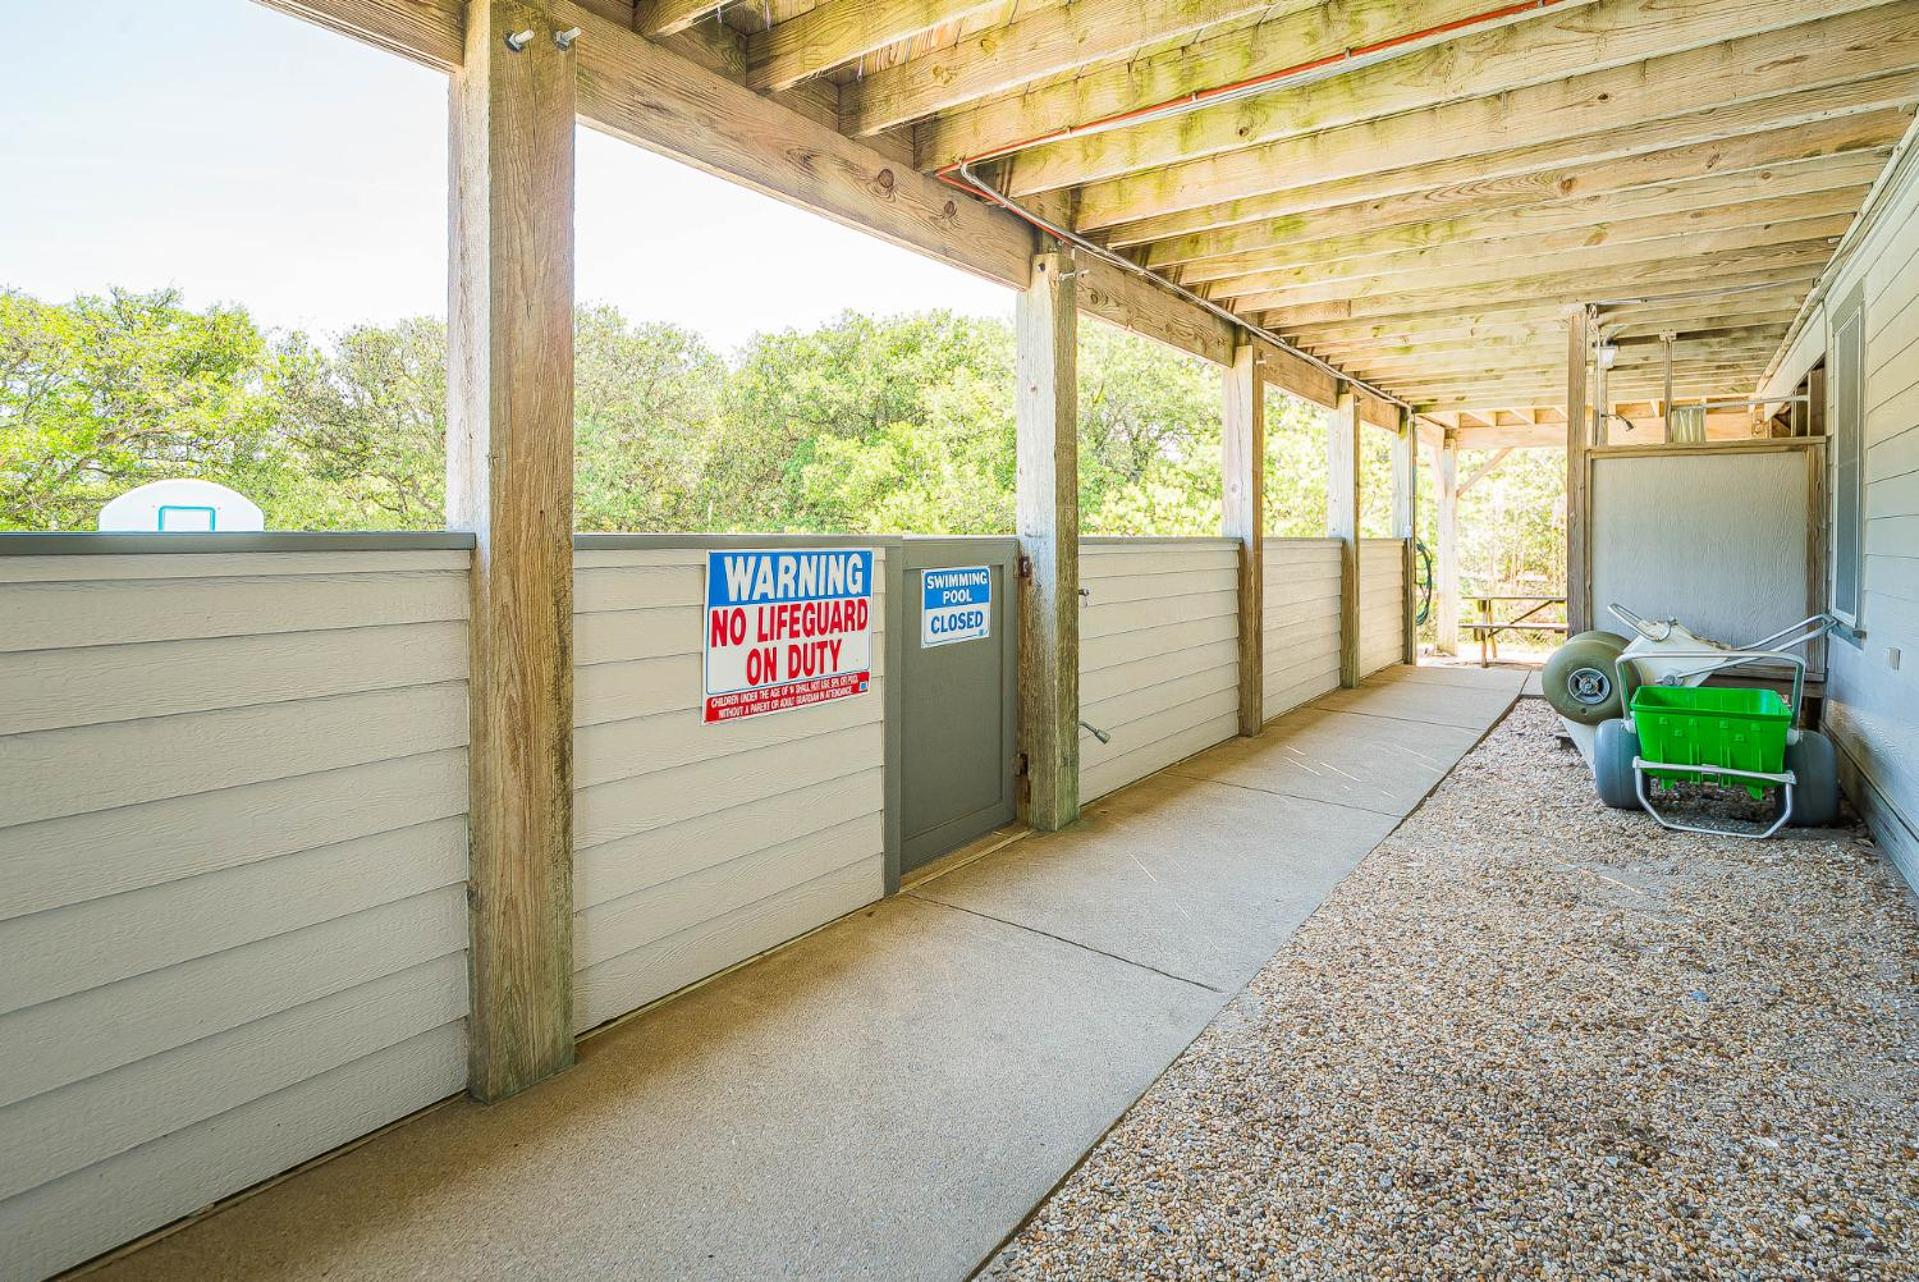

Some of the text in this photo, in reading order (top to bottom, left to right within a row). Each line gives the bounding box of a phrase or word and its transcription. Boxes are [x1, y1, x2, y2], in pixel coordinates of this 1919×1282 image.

[724, 553, 863, 602] WARNING
[927, 571, 987, 589] SWIMMING
[943, 589, 972, 604] POOL
[711, 598, 868, 648] NO LIFEGUARD
[931, 611, 983, 634] CLOSED
[746, 639, 842, 686] ON DUTY
[711, 696, 739, 708] CHILDREN
[741, 692, 757, 703] UNDER
[760, 690, 770, 699] THE
[770, 688, 781, 698] AGE
[782, 686, 788, 695] OF
[796, 683, 810, 694] SHALL
[810, 681, 820, 691] NOT
[821, 679, 830, 689] USE
[831, 678, 839, 686] SPA
[848, 674, 858, 684] POOL
[719, 686, 852, 718] WITHOUT A PARENT OR ADULT GUARDIAN IN ATTENDANCE
